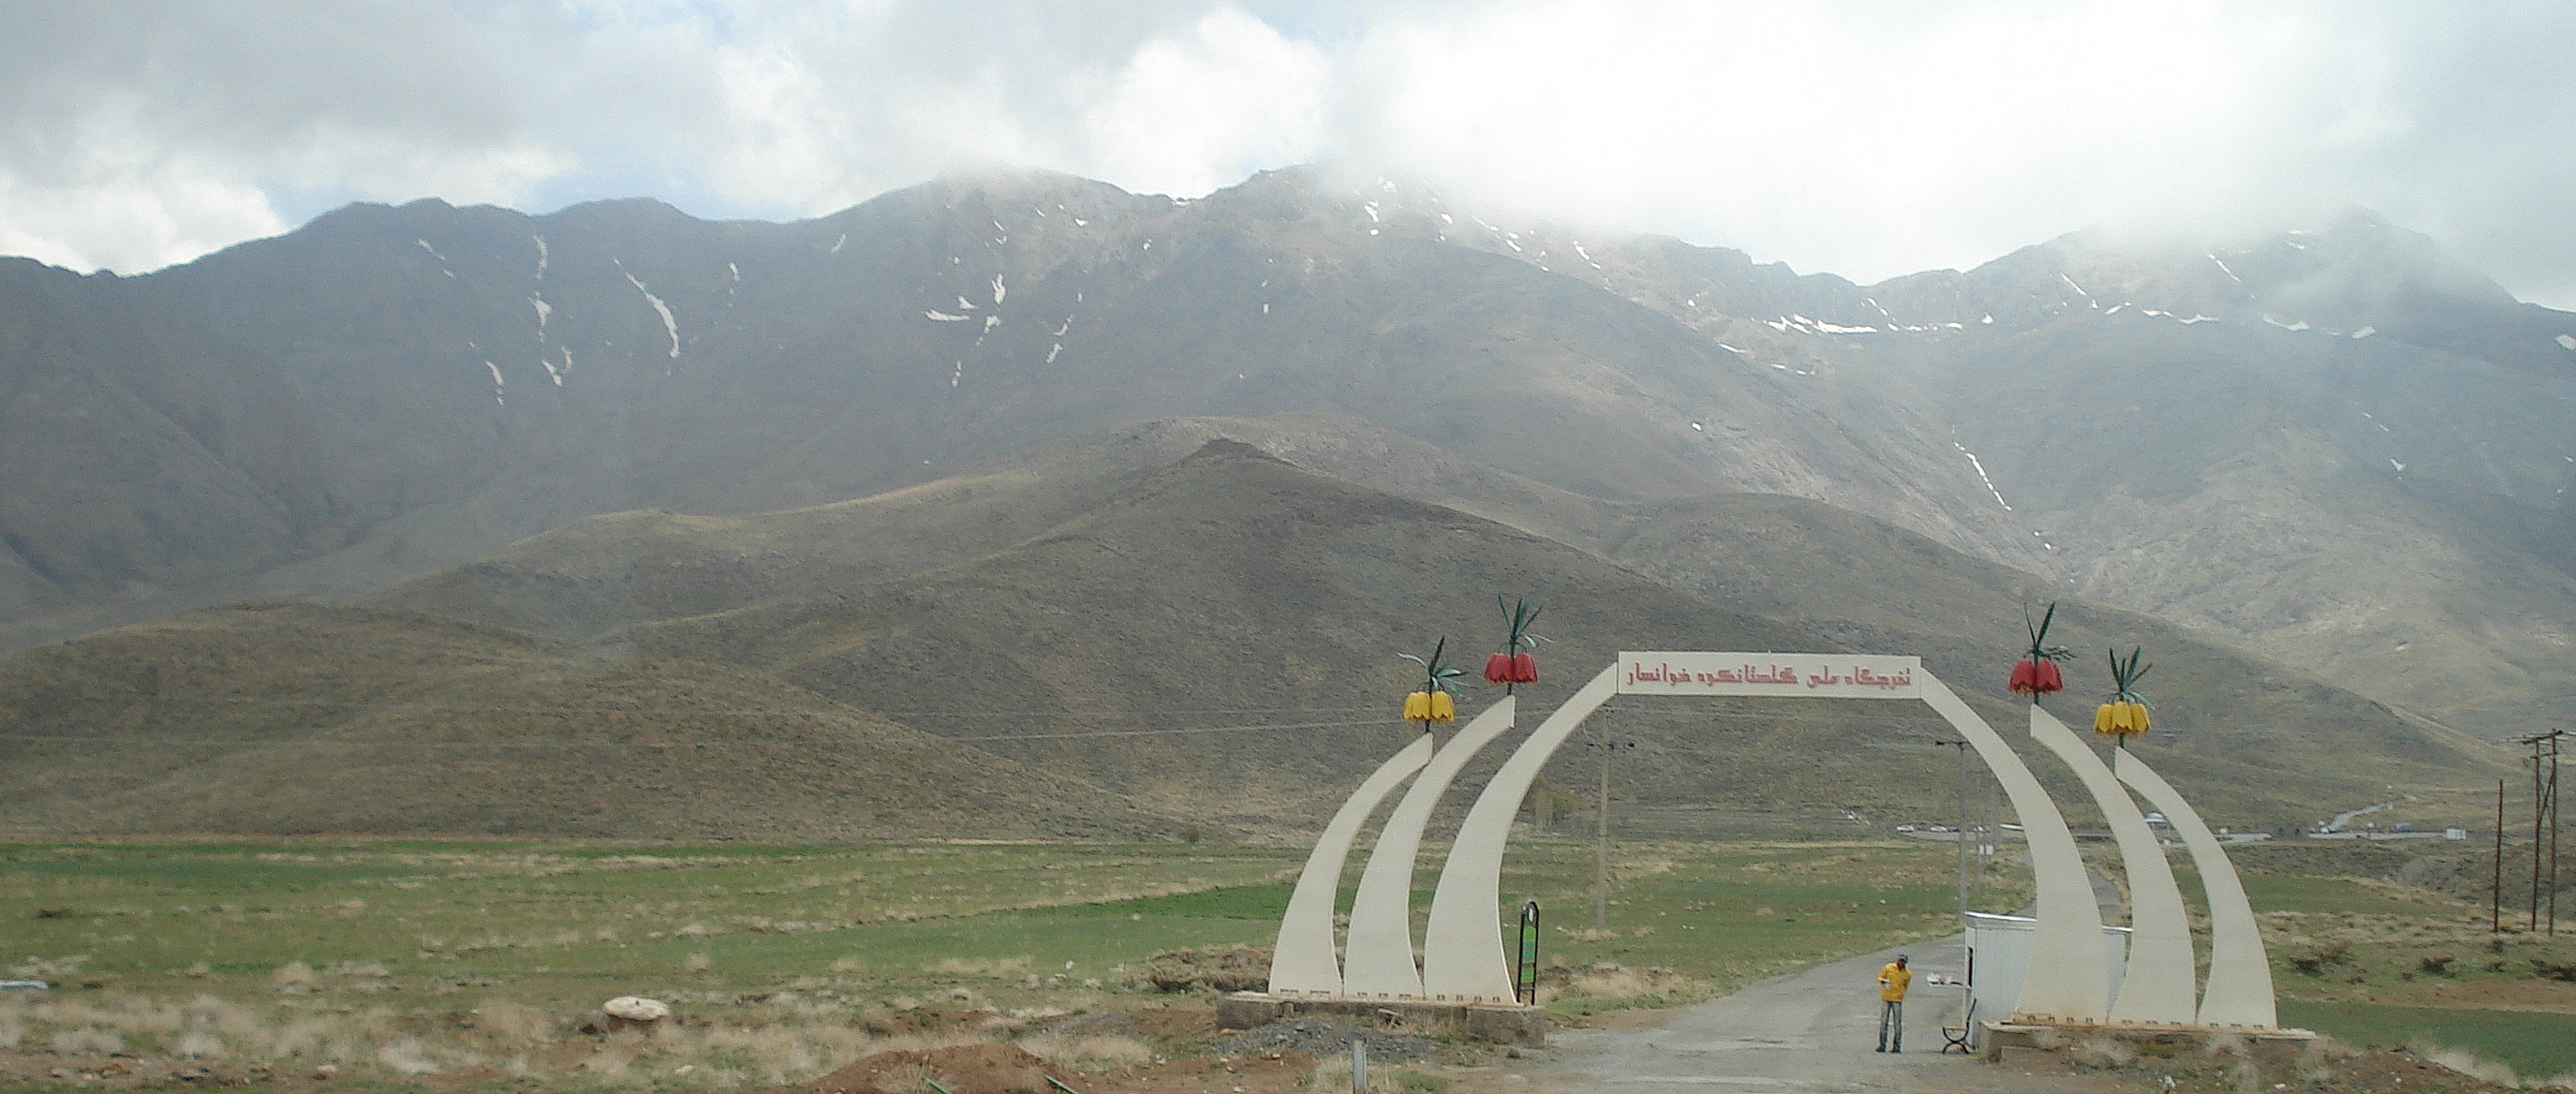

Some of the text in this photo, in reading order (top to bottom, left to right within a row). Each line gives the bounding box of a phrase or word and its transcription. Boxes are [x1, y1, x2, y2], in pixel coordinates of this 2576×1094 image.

[1626, 661, 1911, 689] تفرجگاه ملی گلستانکوه خوانسار
